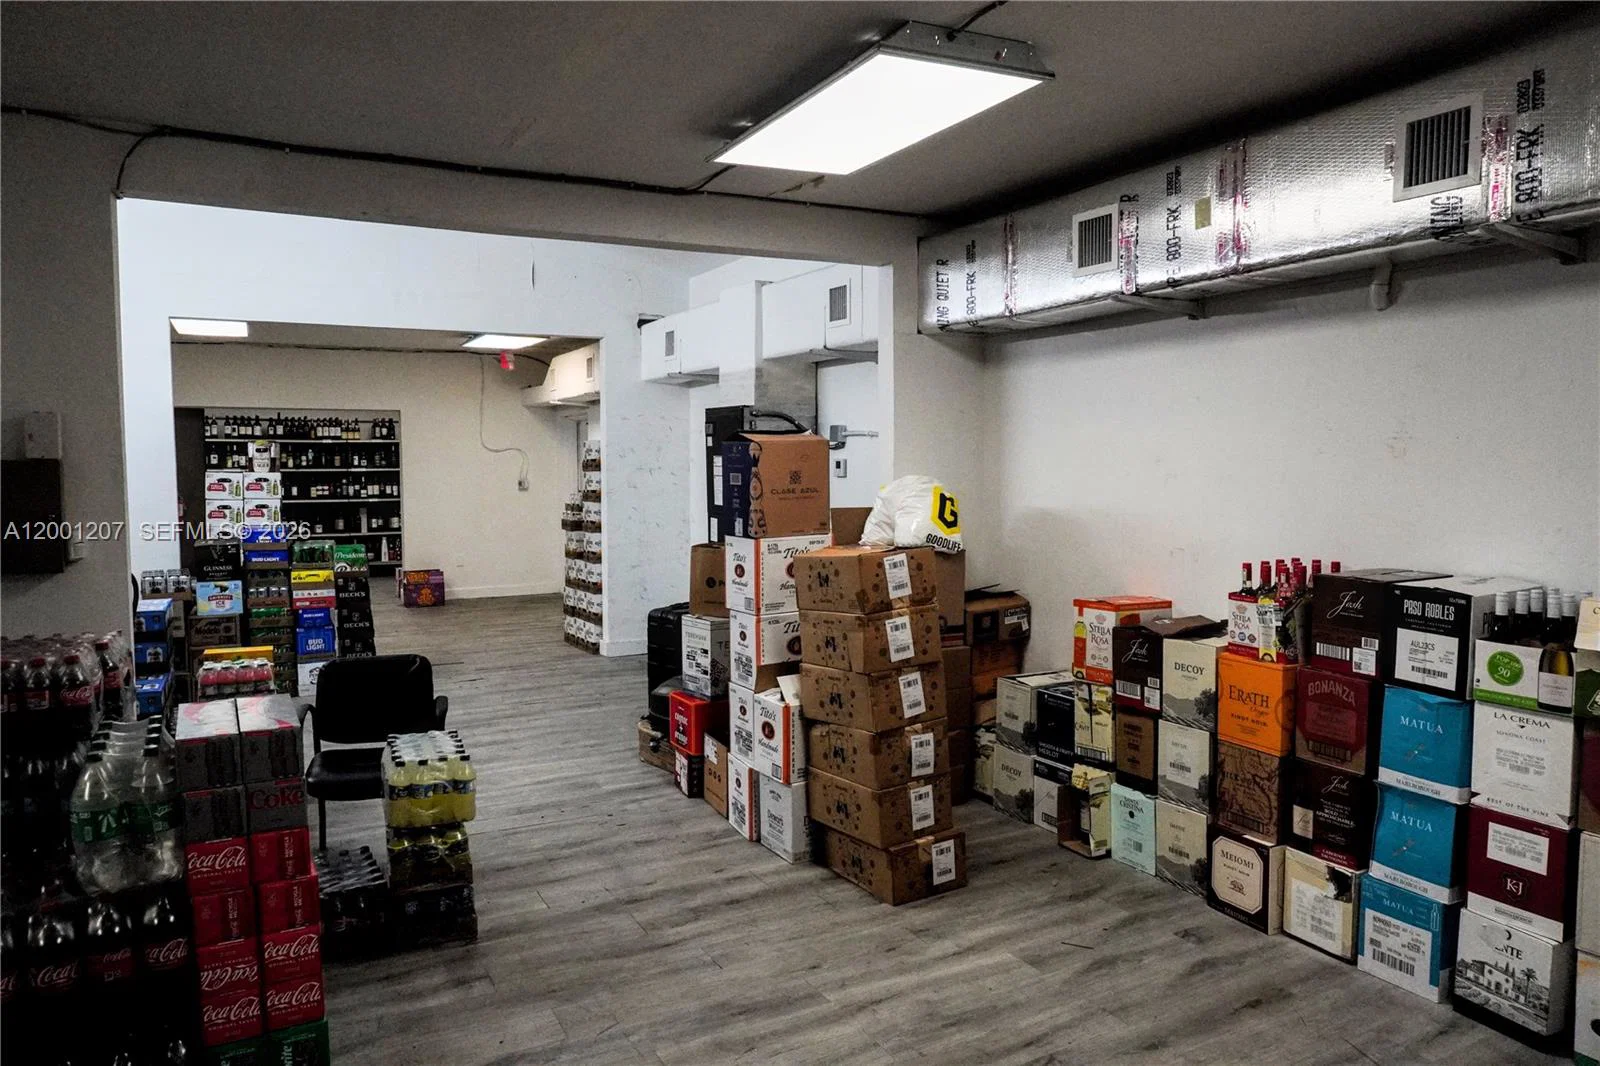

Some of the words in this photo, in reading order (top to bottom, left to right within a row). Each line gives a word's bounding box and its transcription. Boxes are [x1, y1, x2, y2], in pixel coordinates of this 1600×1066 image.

[1167, 205, 1182, 262] 800-FRK
[936, 271, 950, 300] QUIET
[966, 271, 977, 315] 800-FRK
[770, 487, 797, 495] CLASE
[938, 492, 958, 529] G
[925, 533, 962, 553] GOODLIFE
[1232, 612, 1252, 623] STELLA
[1403, 599, 1423, 616] PASO
[1424, 602, 1455, 622] ROBLES
[1089, 622, 1112, 636] STELLA
[1234, 620, 1250, 630] ROSA
[1091, 634, 1110, 646] ROSA
[1174, 661, 1205, 676] DECOY
[1497, 666, 1511, 678] 90
[1228, 685, 1270, 709] ERATH
[1307, 680, 1357, 707] BONANZA
[759, 706, 777, 722] Tito's
[1493, 711, 1507, 722] LA
[1510, 714, 1551, 730] CREMA
[1400, 715, 1443, 735] MATUA
[1525, 735, 1546, 744] COAST
[1001, 763, 1022, 777] DECOY
[1395, 777, 1441, 796] MARLBOROUGH
[250, 786, 304, 810] Coke
[1390, 810, 1433, 833] MATUA
[1219, 849, 1255, 871] MEIOMI
[1382, 897, 1414, 917] MATUA
